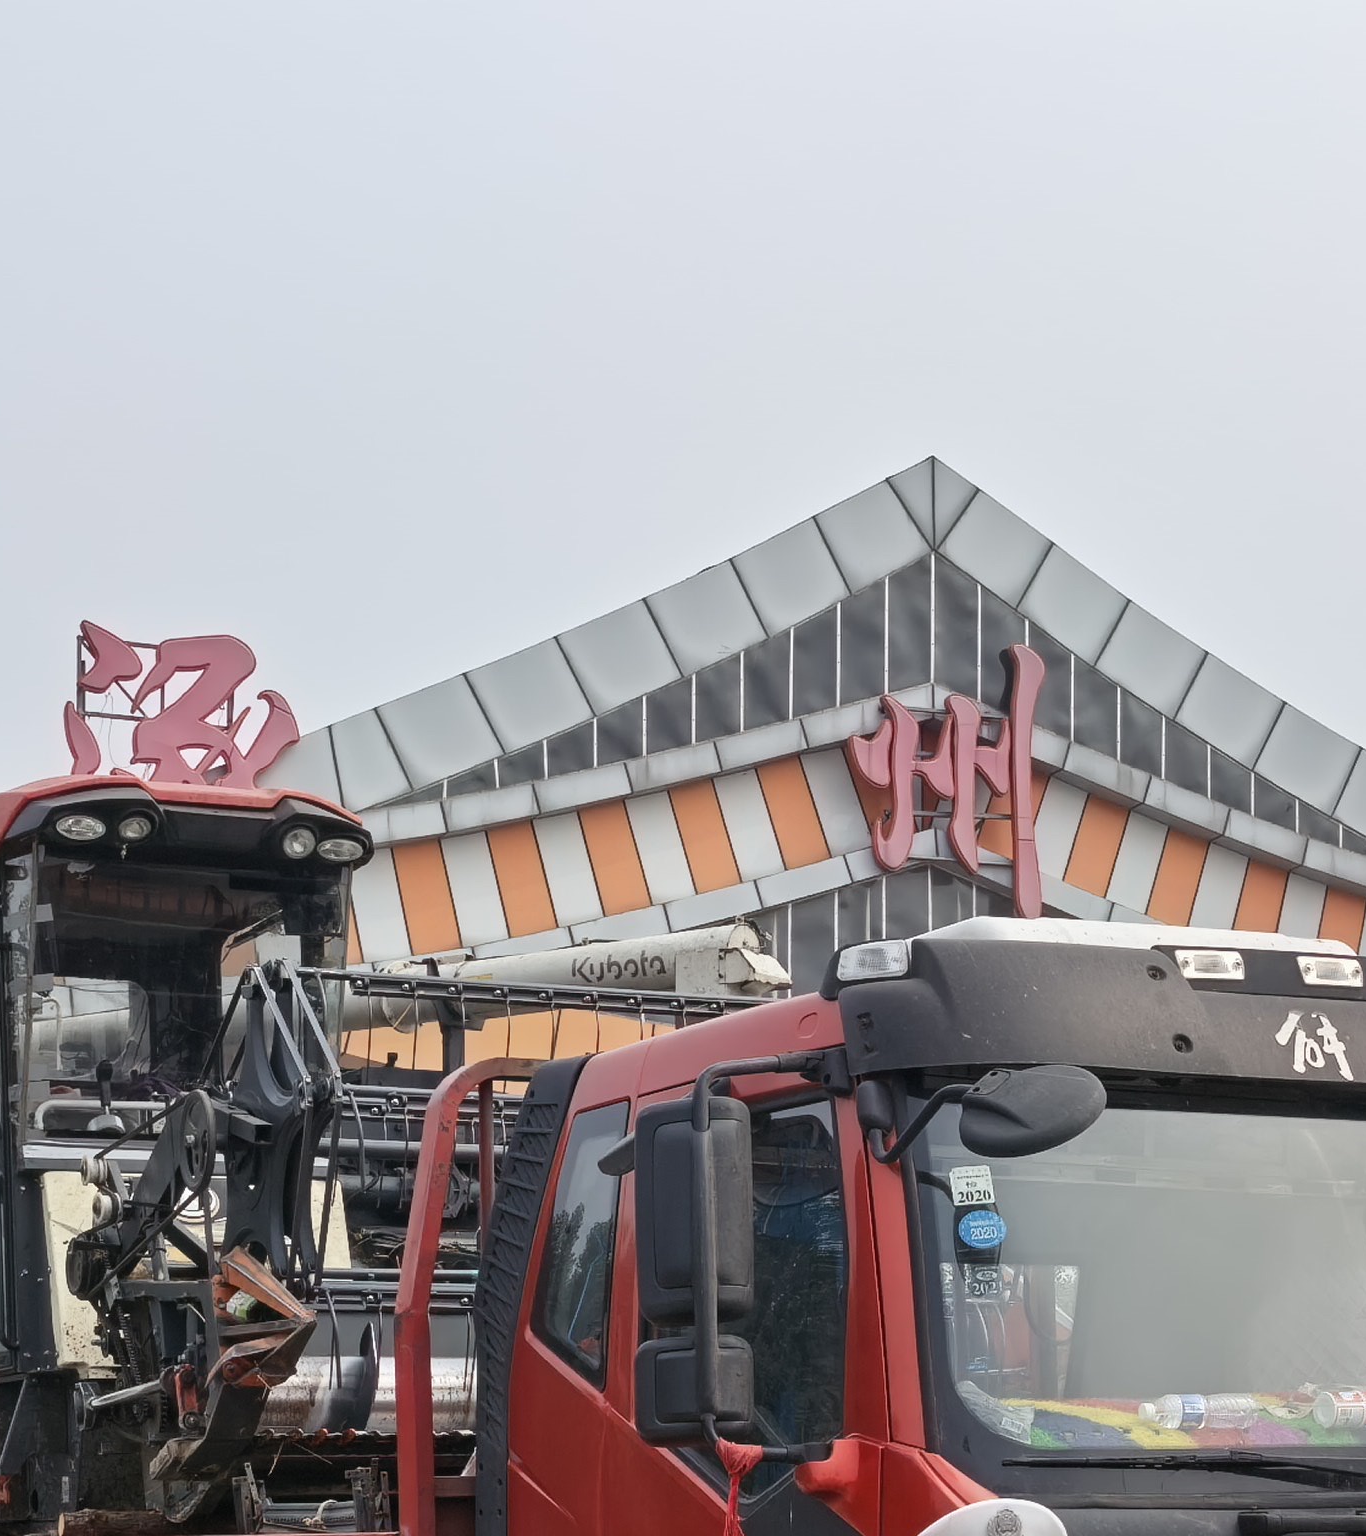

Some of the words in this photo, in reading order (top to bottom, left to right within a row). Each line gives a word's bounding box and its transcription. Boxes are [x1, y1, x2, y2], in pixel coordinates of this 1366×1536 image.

[571, 950, 667, 983] Kubota
[957, 1189, 992, 1204] 2020
[970, 1226, 998, 1240] 2020
